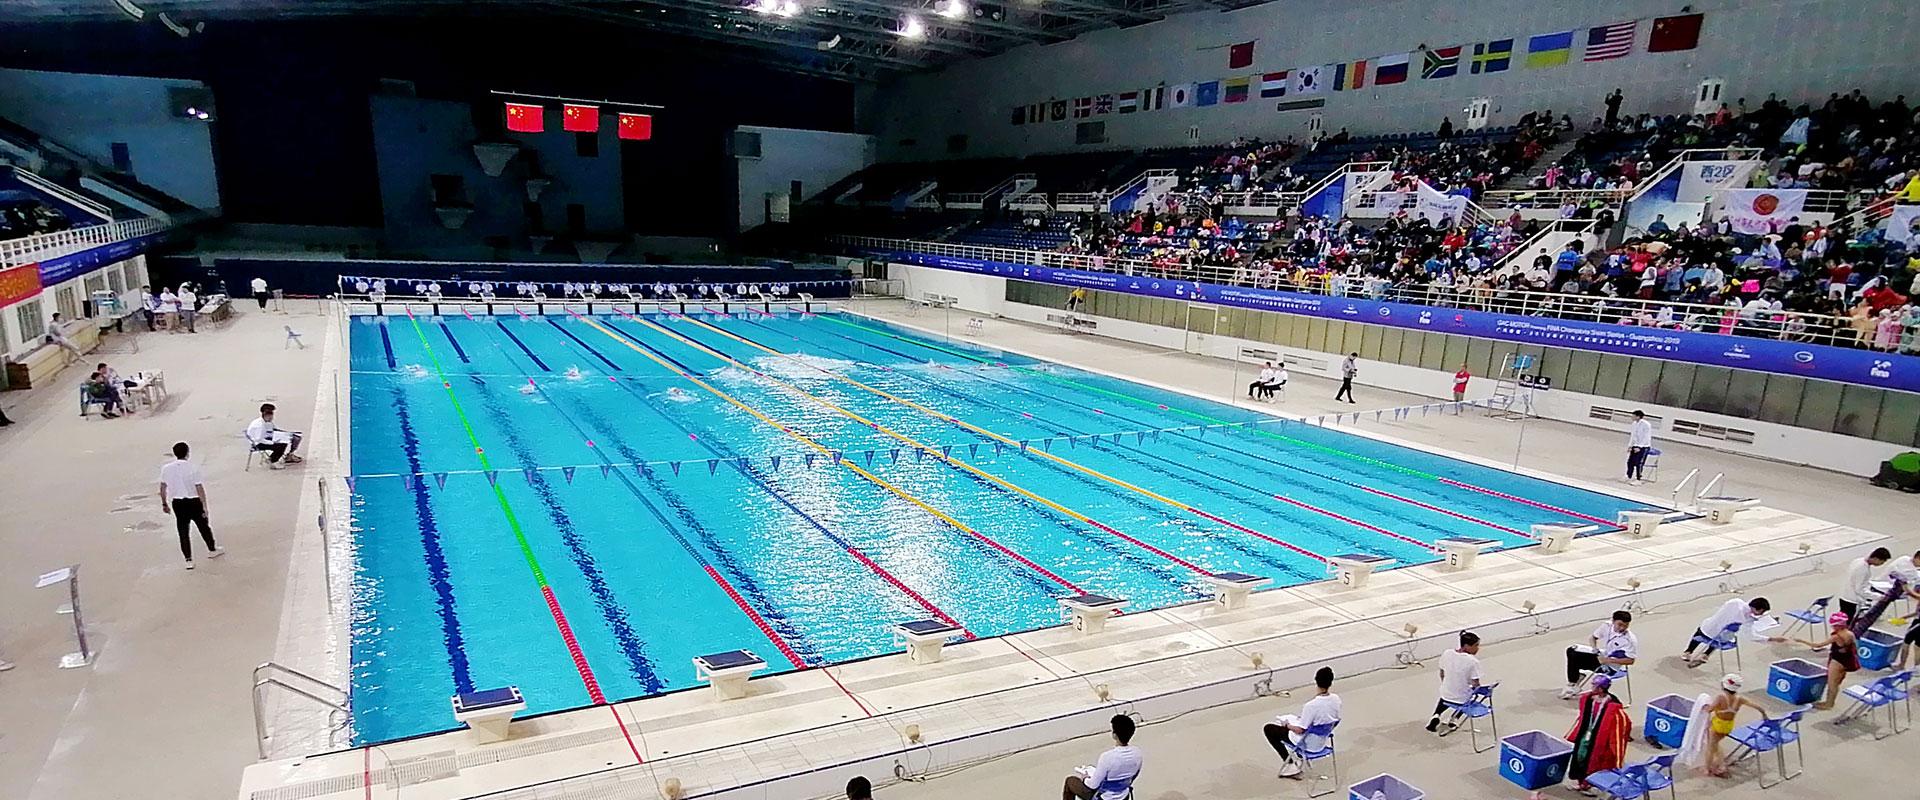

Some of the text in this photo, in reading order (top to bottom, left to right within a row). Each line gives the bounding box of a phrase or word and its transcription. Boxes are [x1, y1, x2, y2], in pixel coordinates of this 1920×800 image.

[1711, 510, 1720, 521] 9
[1633, 523, 1641, 535] 8
[1547, 537, 1554, 549] 7
[1450, 553, 1458, 566] 6
[1343, 571, 1351, 585] 5
[1219, 592, 1226, 607] 4
[1076, 615, 1083, 632] 3
